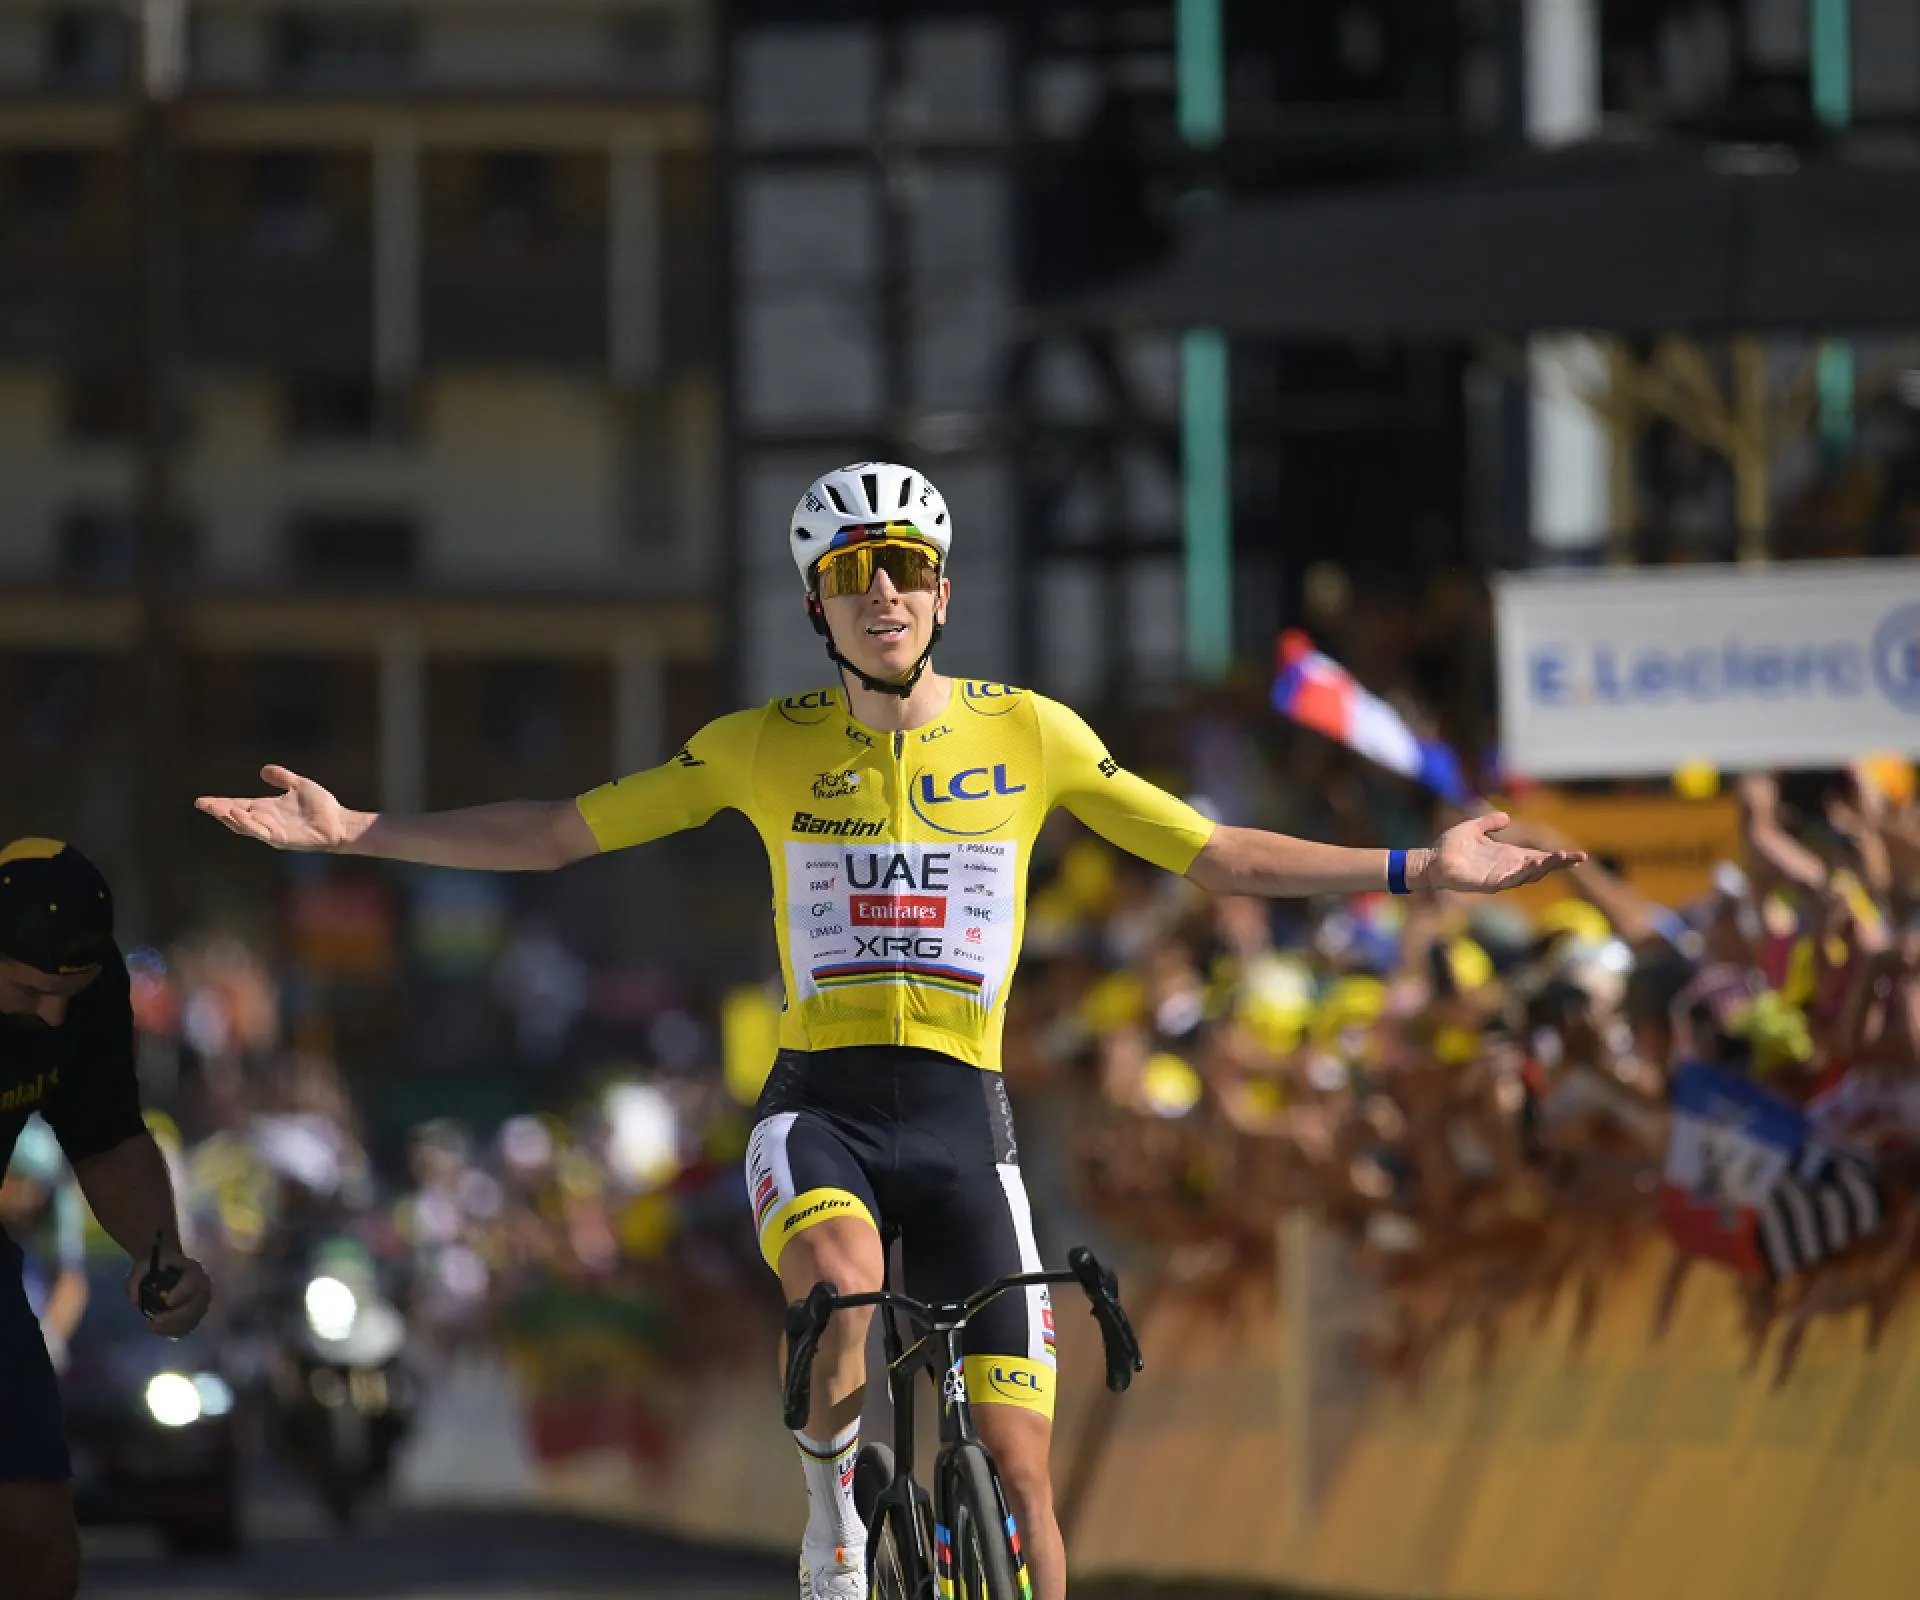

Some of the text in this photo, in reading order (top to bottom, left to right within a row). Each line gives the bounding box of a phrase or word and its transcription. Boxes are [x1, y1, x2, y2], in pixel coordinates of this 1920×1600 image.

[785, 691, 835, 709] LCL
[966, 681, 1022, 697] LCL
[845, 725, 874, 747] LCL
[920, 725, 953, 743] LCL
[921, 764, 1027, 804] LCL
[792, 811, 885, 837] Santini
[846, 853, 951, 891] UAE
[858, 902, 937, 920] Emirates
[853, 936, 943, 959] XRG
[995, 1367, 1042, 1392] LCL
